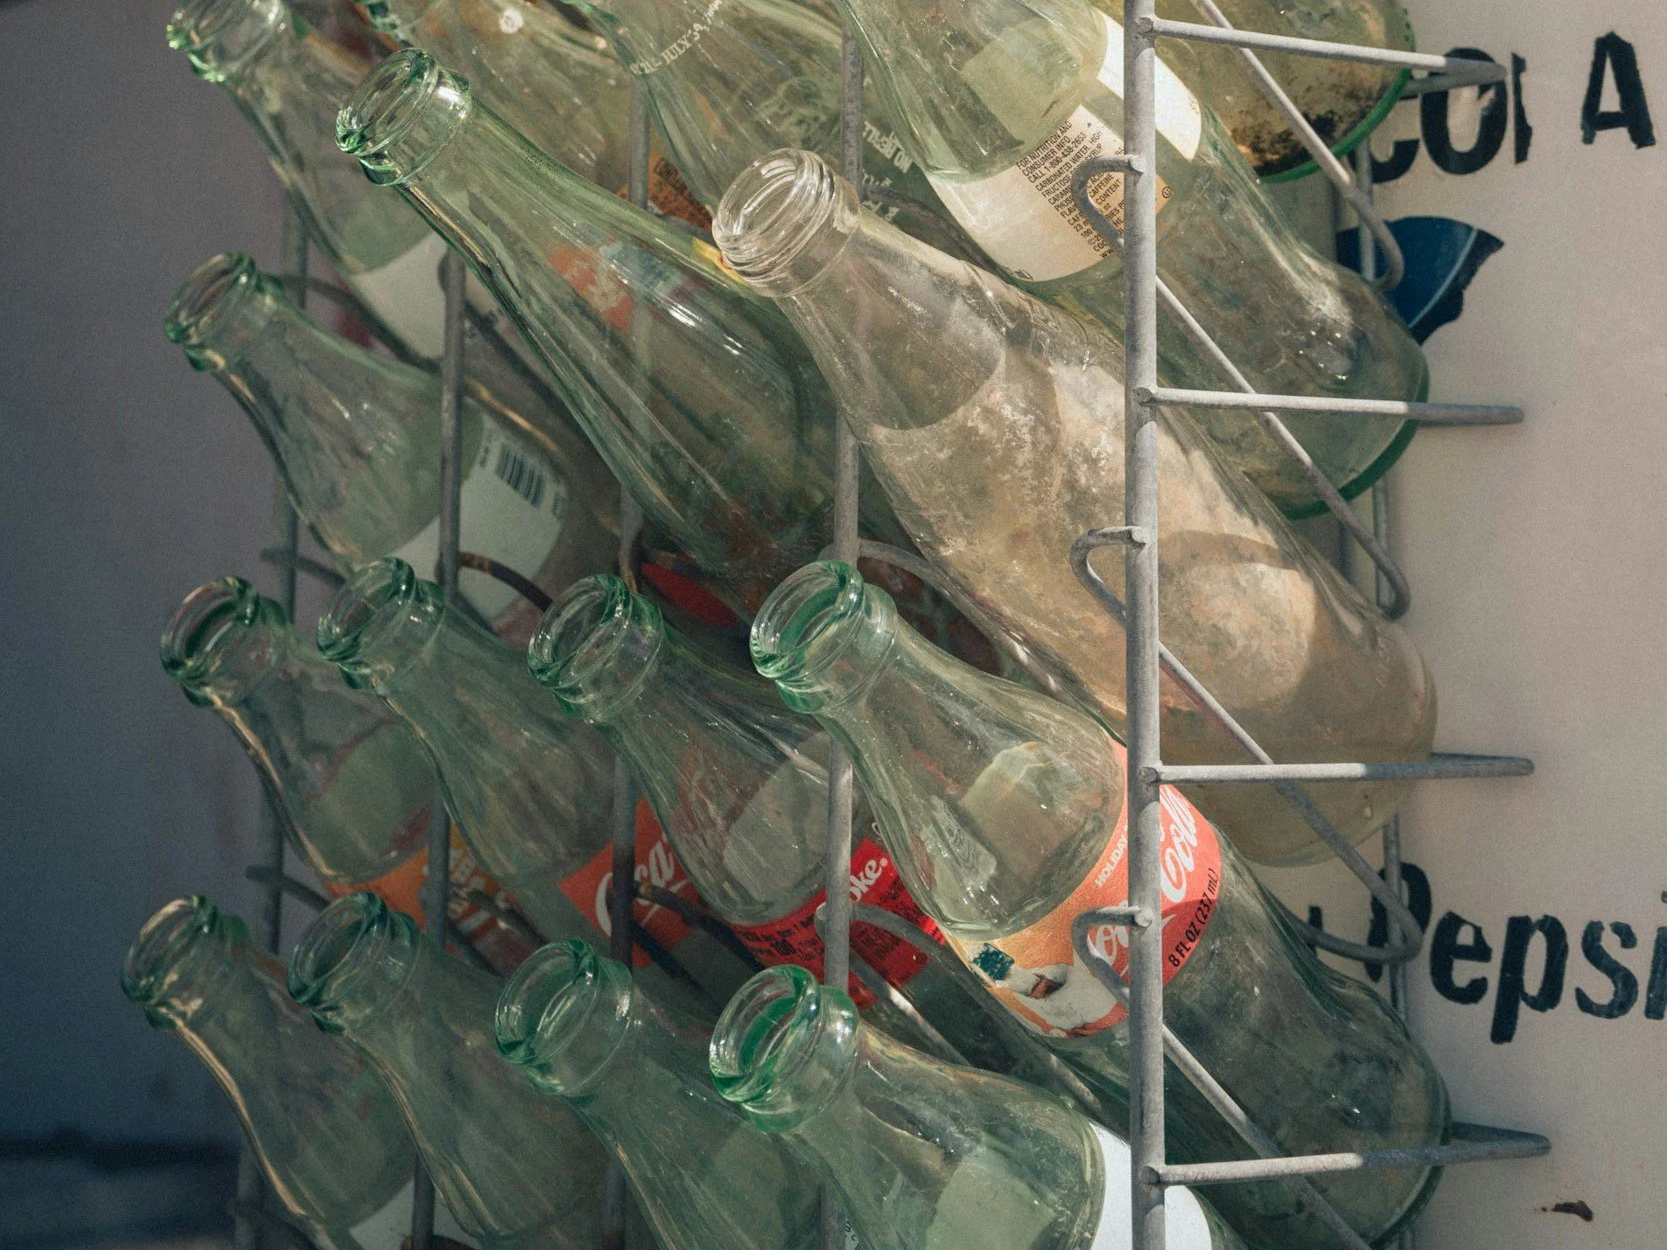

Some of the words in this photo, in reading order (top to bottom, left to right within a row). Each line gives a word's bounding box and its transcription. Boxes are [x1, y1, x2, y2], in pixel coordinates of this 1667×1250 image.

[1016, 156, 1031, 170] FOR
[1028, 132, 1061, 160] NUTRITION
[1058, 120, 1072, 136] AND
[1022, 148, 1057, 176] CONSUMER
[1028, 170, 1046, 183] CALL
[1035, 161, 1072, 191] CARBONATED
[1095, 179, 1122, 205] CONTENT
[848, 857, 883, 904] oke
[1094, 833, 1128, 888] HOLIDAY
[1168, 953, 1180, 968] 8
[1174, 941, 1190, 959] FL
[1185, 921, 1201, 943] OZ
[1194, 892, 1214, 926] (237
[1364, 861, 1667, 1044] Pepsi
